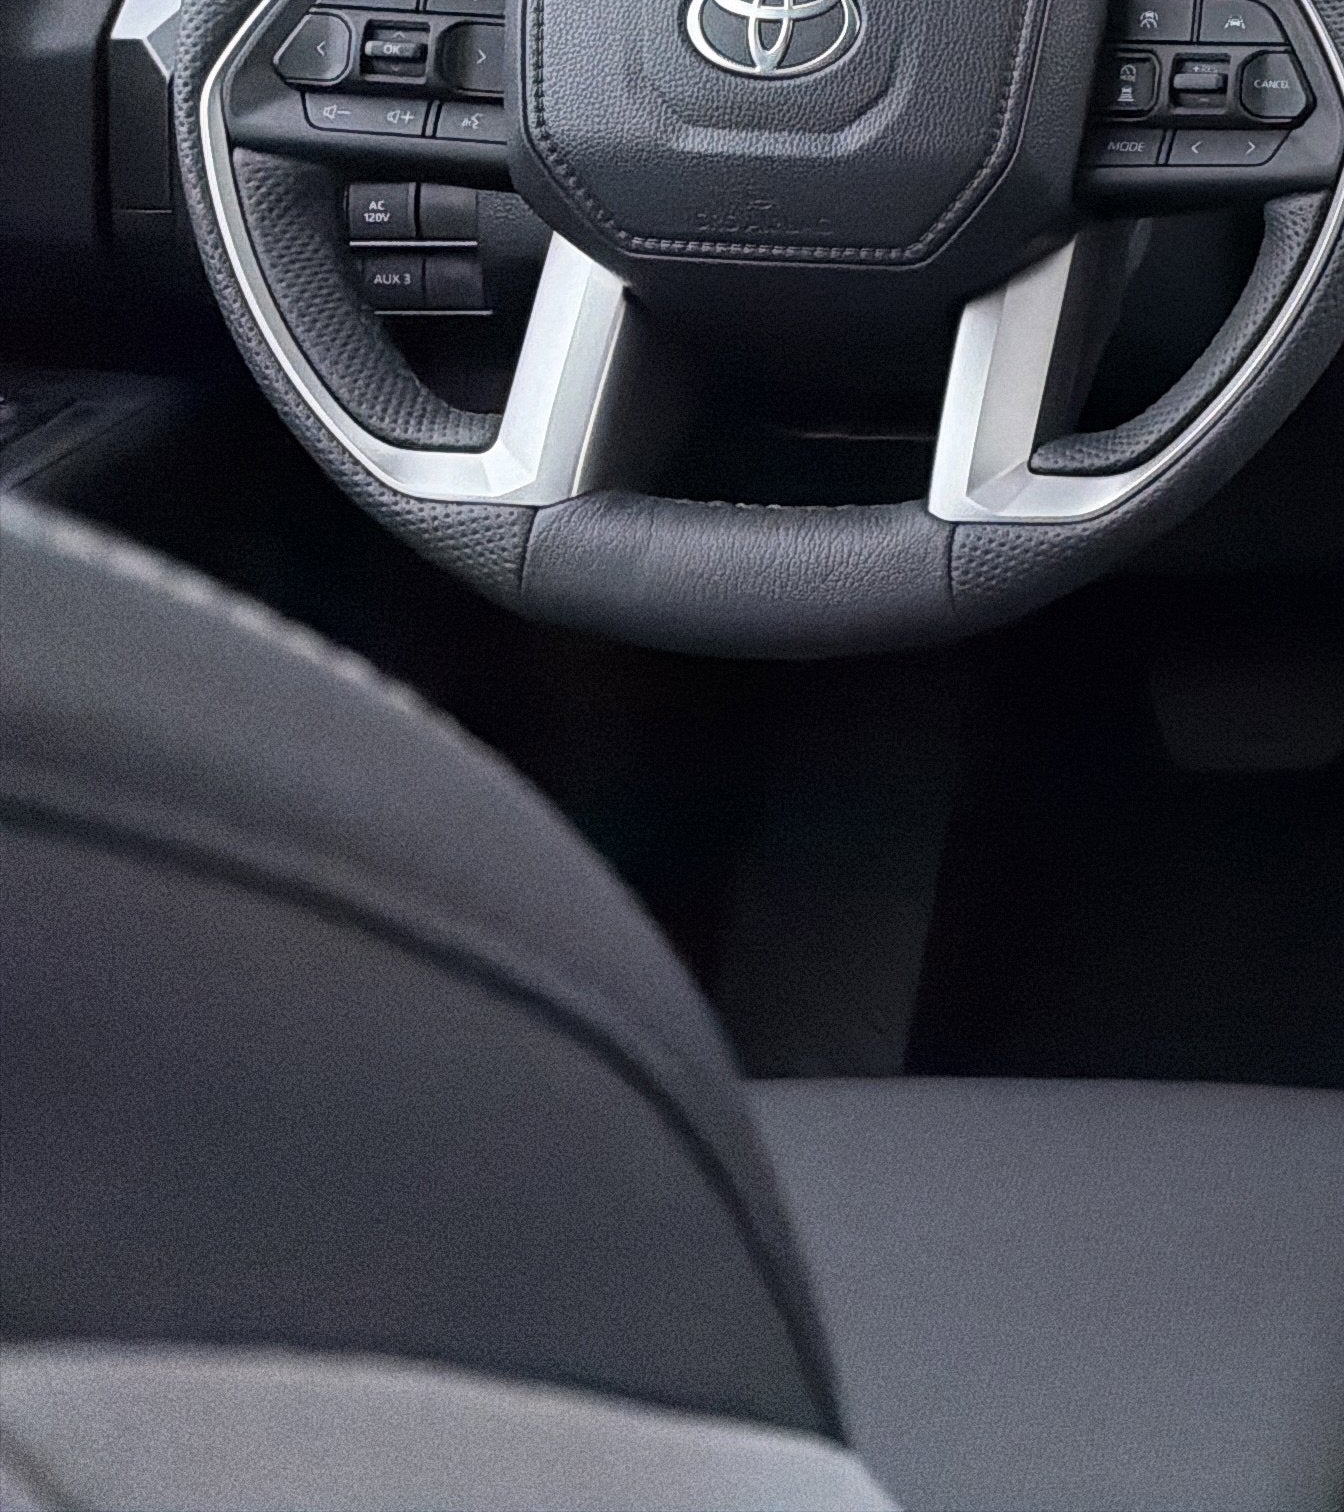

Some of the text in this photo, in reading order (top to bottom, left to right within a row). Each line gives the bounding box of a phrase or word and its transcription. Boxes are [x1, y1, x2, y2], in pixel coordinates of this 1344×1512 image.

[383, 44, 400, 55] OK
[1253, 79, 1289, 89] CANCEL
[1107, 141, 1146, 153] MODE
[368, 200, 385, 211] AC
[363, 212, 391, 223] 120V
[373, 272, 411, 285] AUX 3
